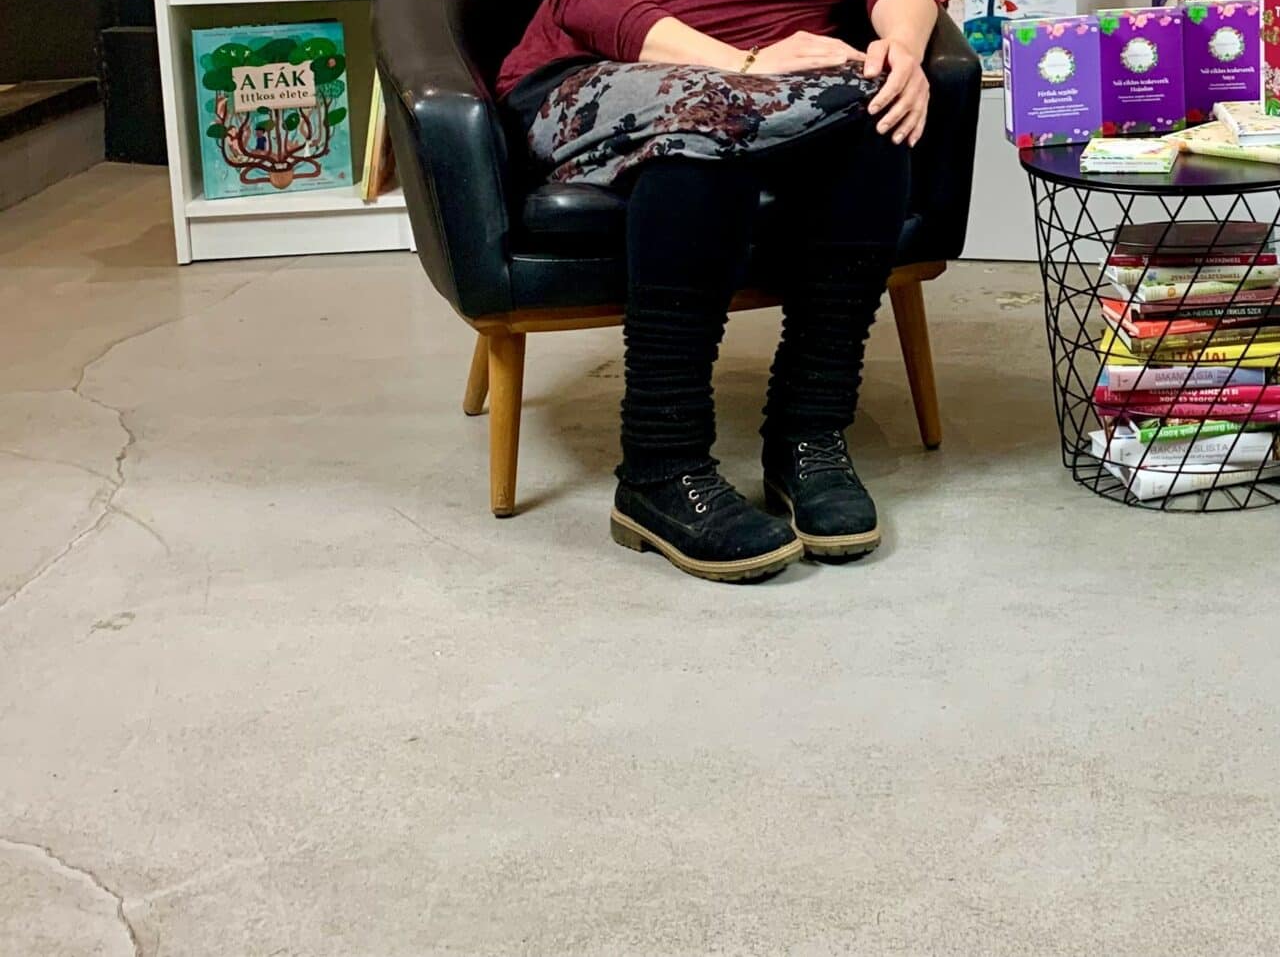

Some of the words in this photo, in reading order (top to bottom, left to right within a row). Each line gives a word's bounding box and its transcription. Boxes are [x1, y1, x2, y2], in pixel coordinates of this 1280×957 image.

[241, 75, 255, 90] A
[264, 67, 306, 89] FÁK
[240, 92, 275, 104] titkos
[279, 88, 309, 101] élete
